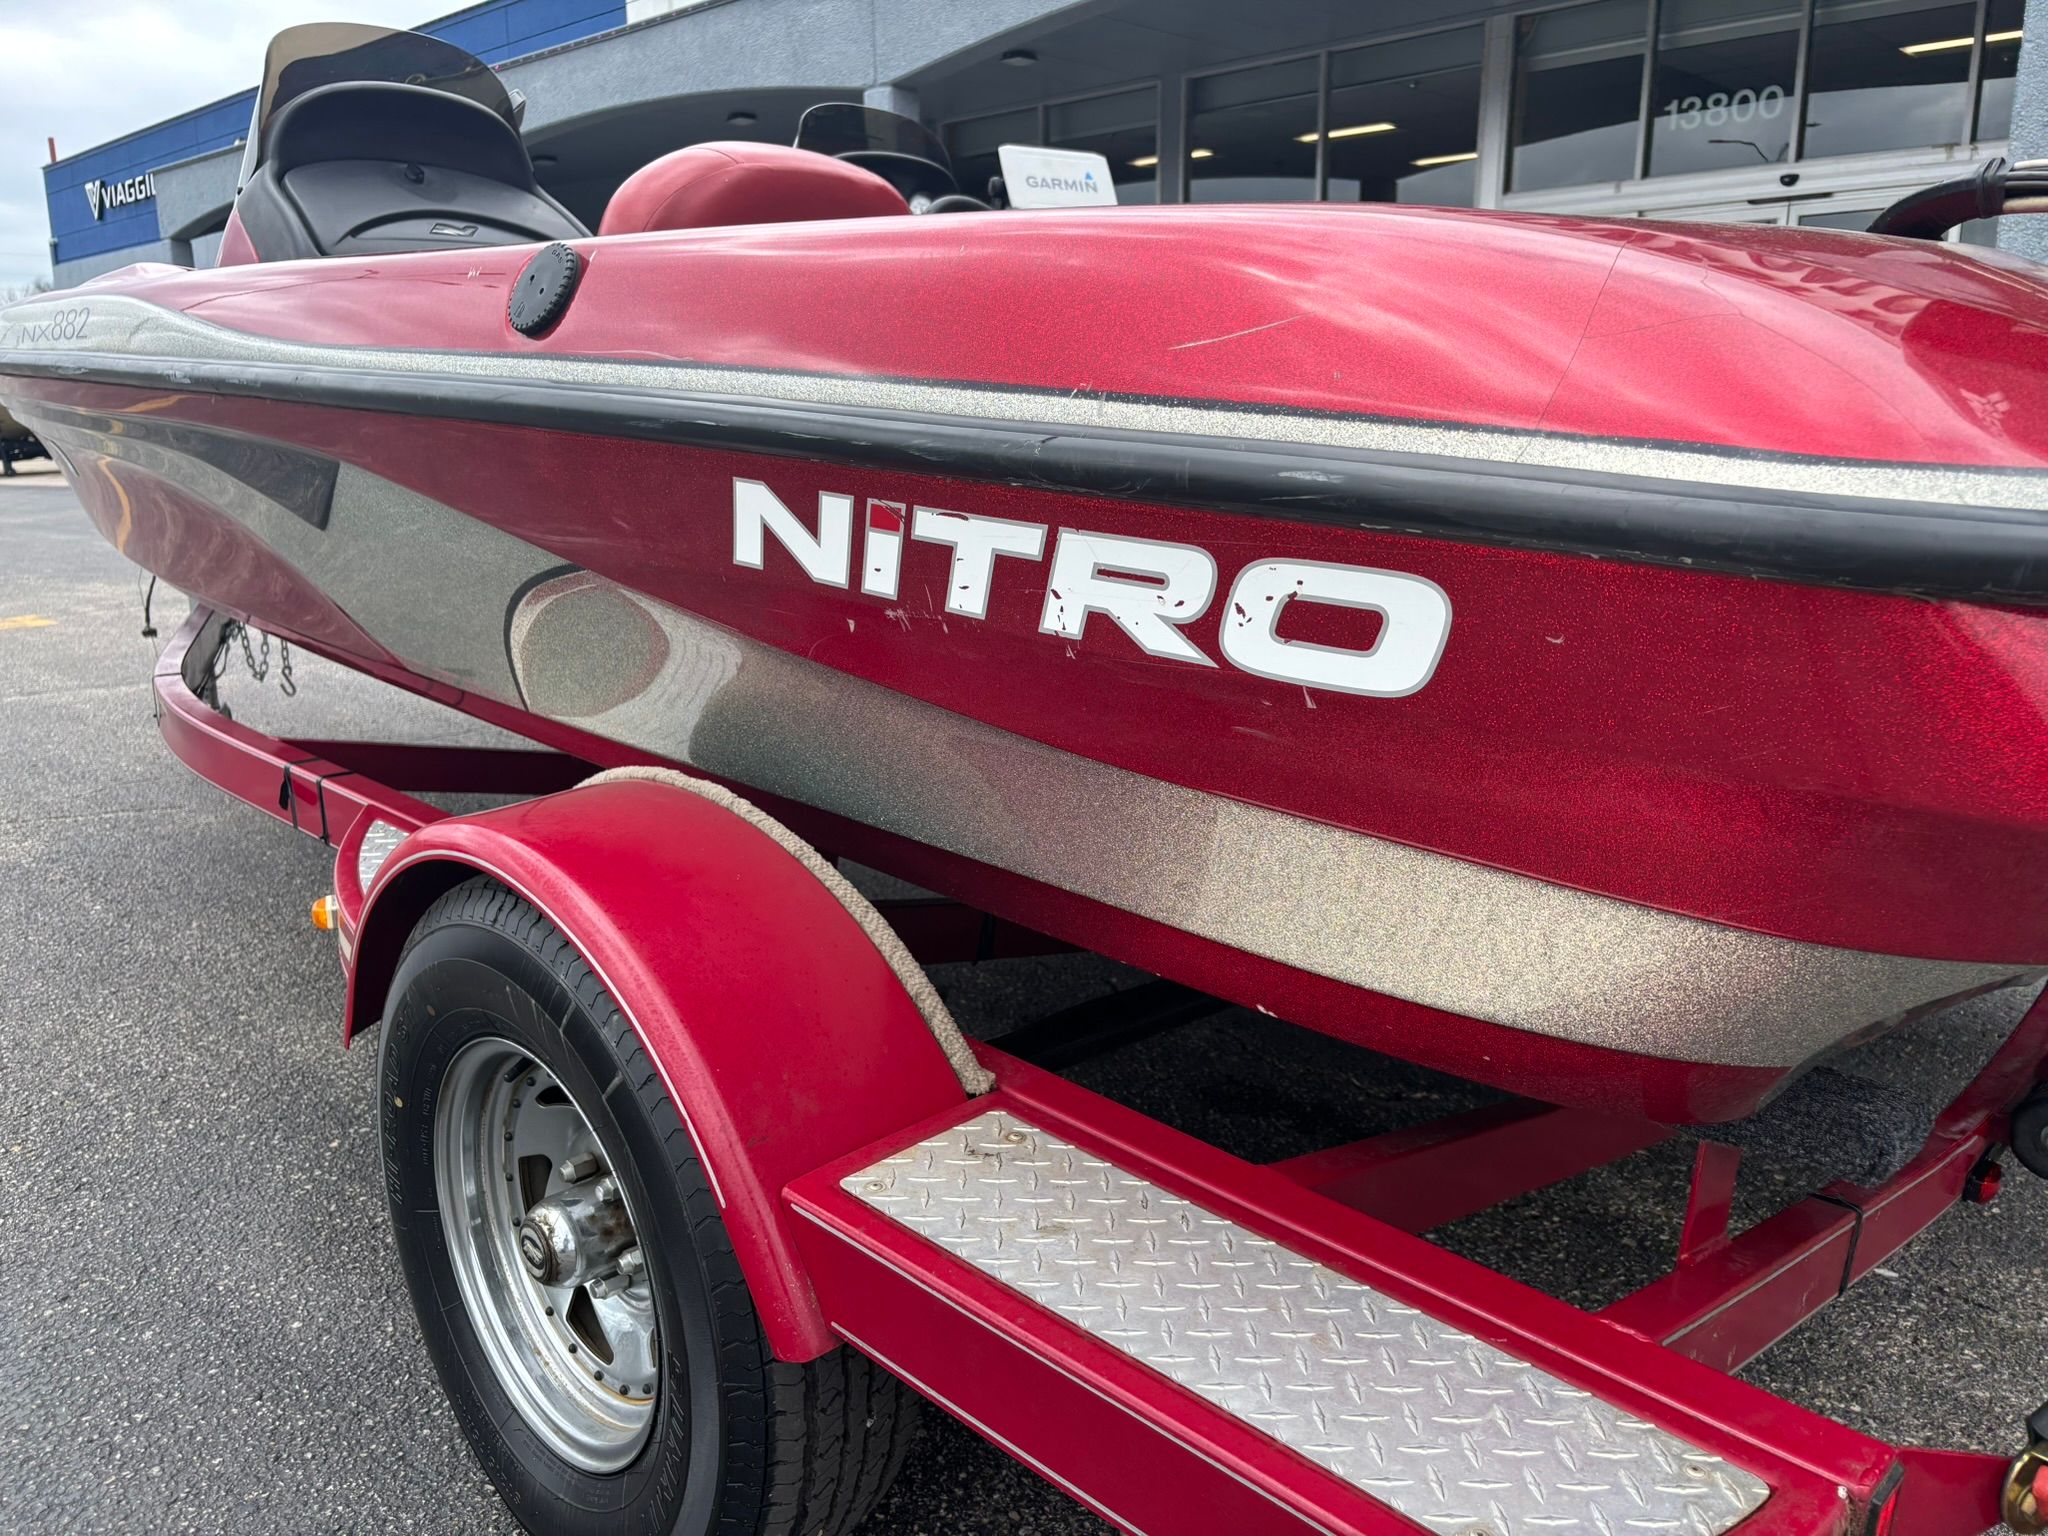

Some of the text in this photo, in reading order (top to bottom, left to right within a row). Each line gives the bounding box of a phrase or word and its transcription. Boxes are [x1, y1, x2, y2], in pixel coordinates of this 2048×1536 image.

[1664, 84, 1785, 131] 13800
[1026, 175, 1099, 193] GARMIN
[21, 306, 91, 343] NX882
